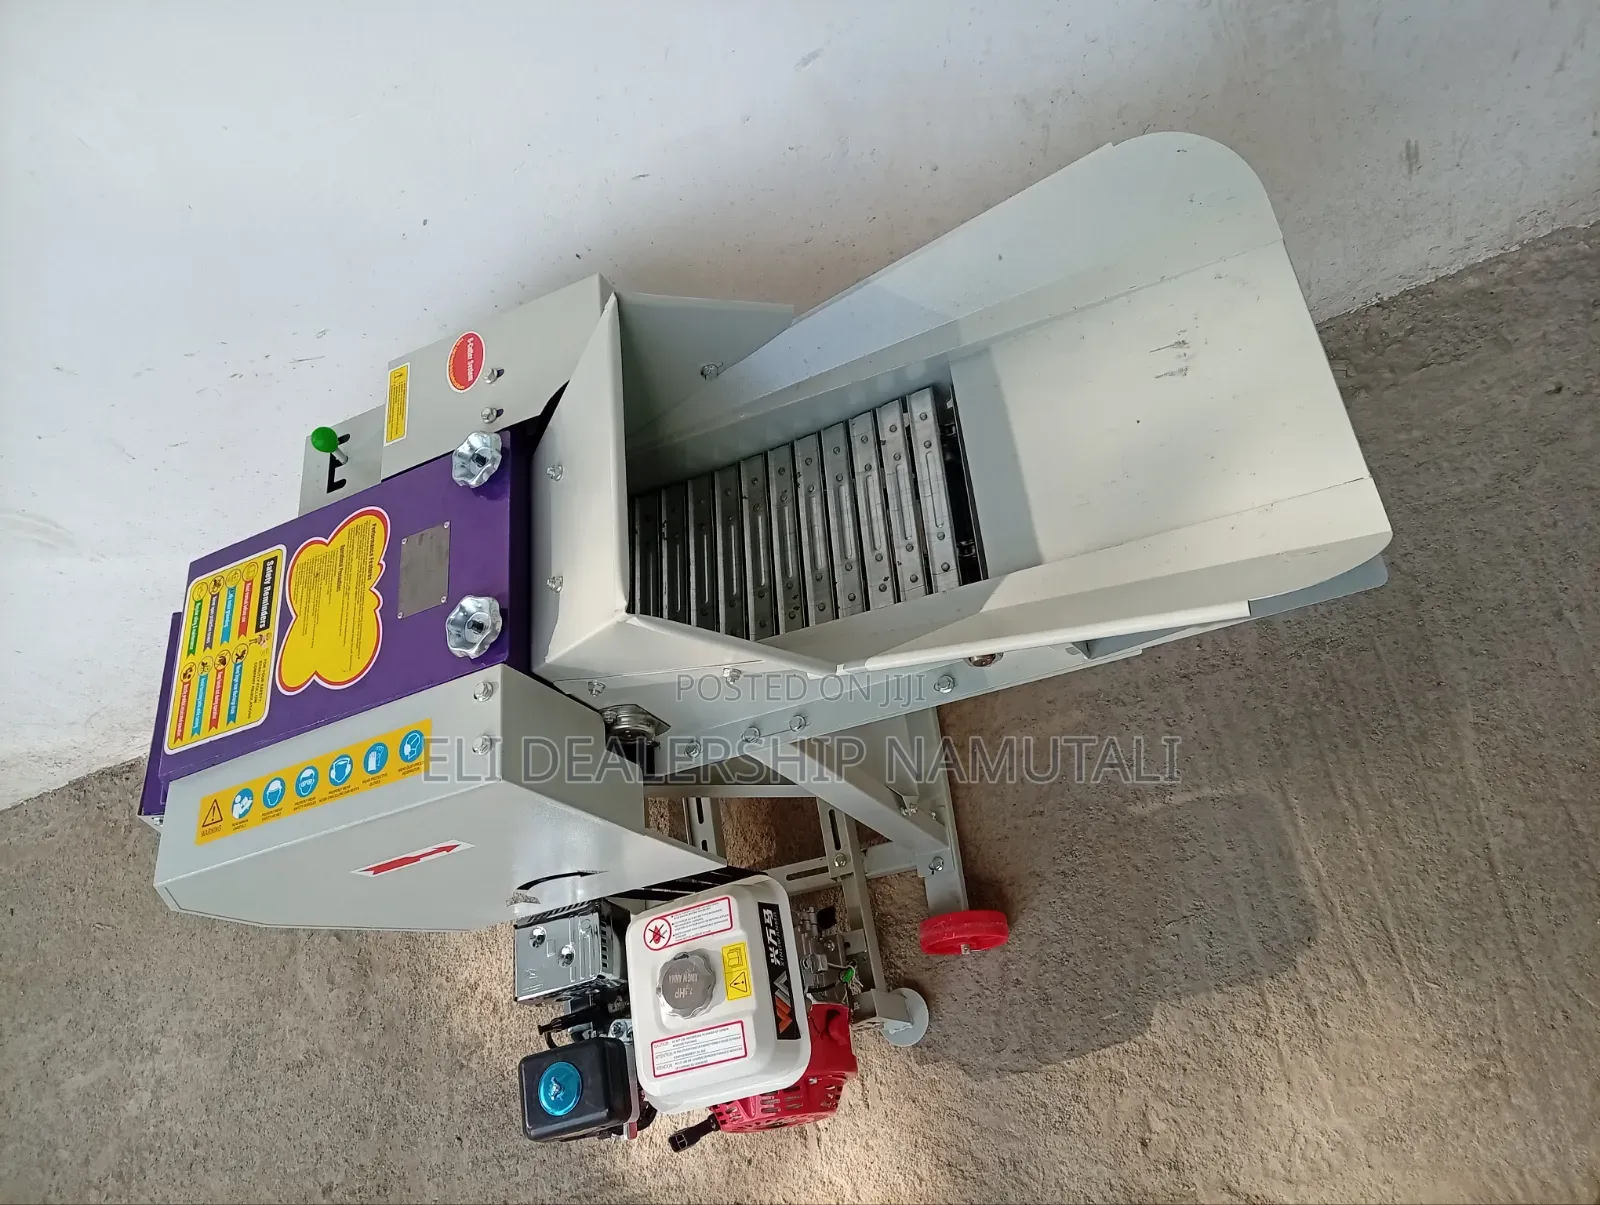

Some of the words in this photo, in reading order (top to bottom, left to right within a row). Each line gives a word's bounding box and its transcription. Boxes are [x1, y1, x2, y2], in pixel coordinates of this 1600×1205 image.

[263, 559, 274, 585] Safety
[258, 584, 271, 629] Reminders
[201, 824, 221, 837] WARNING
